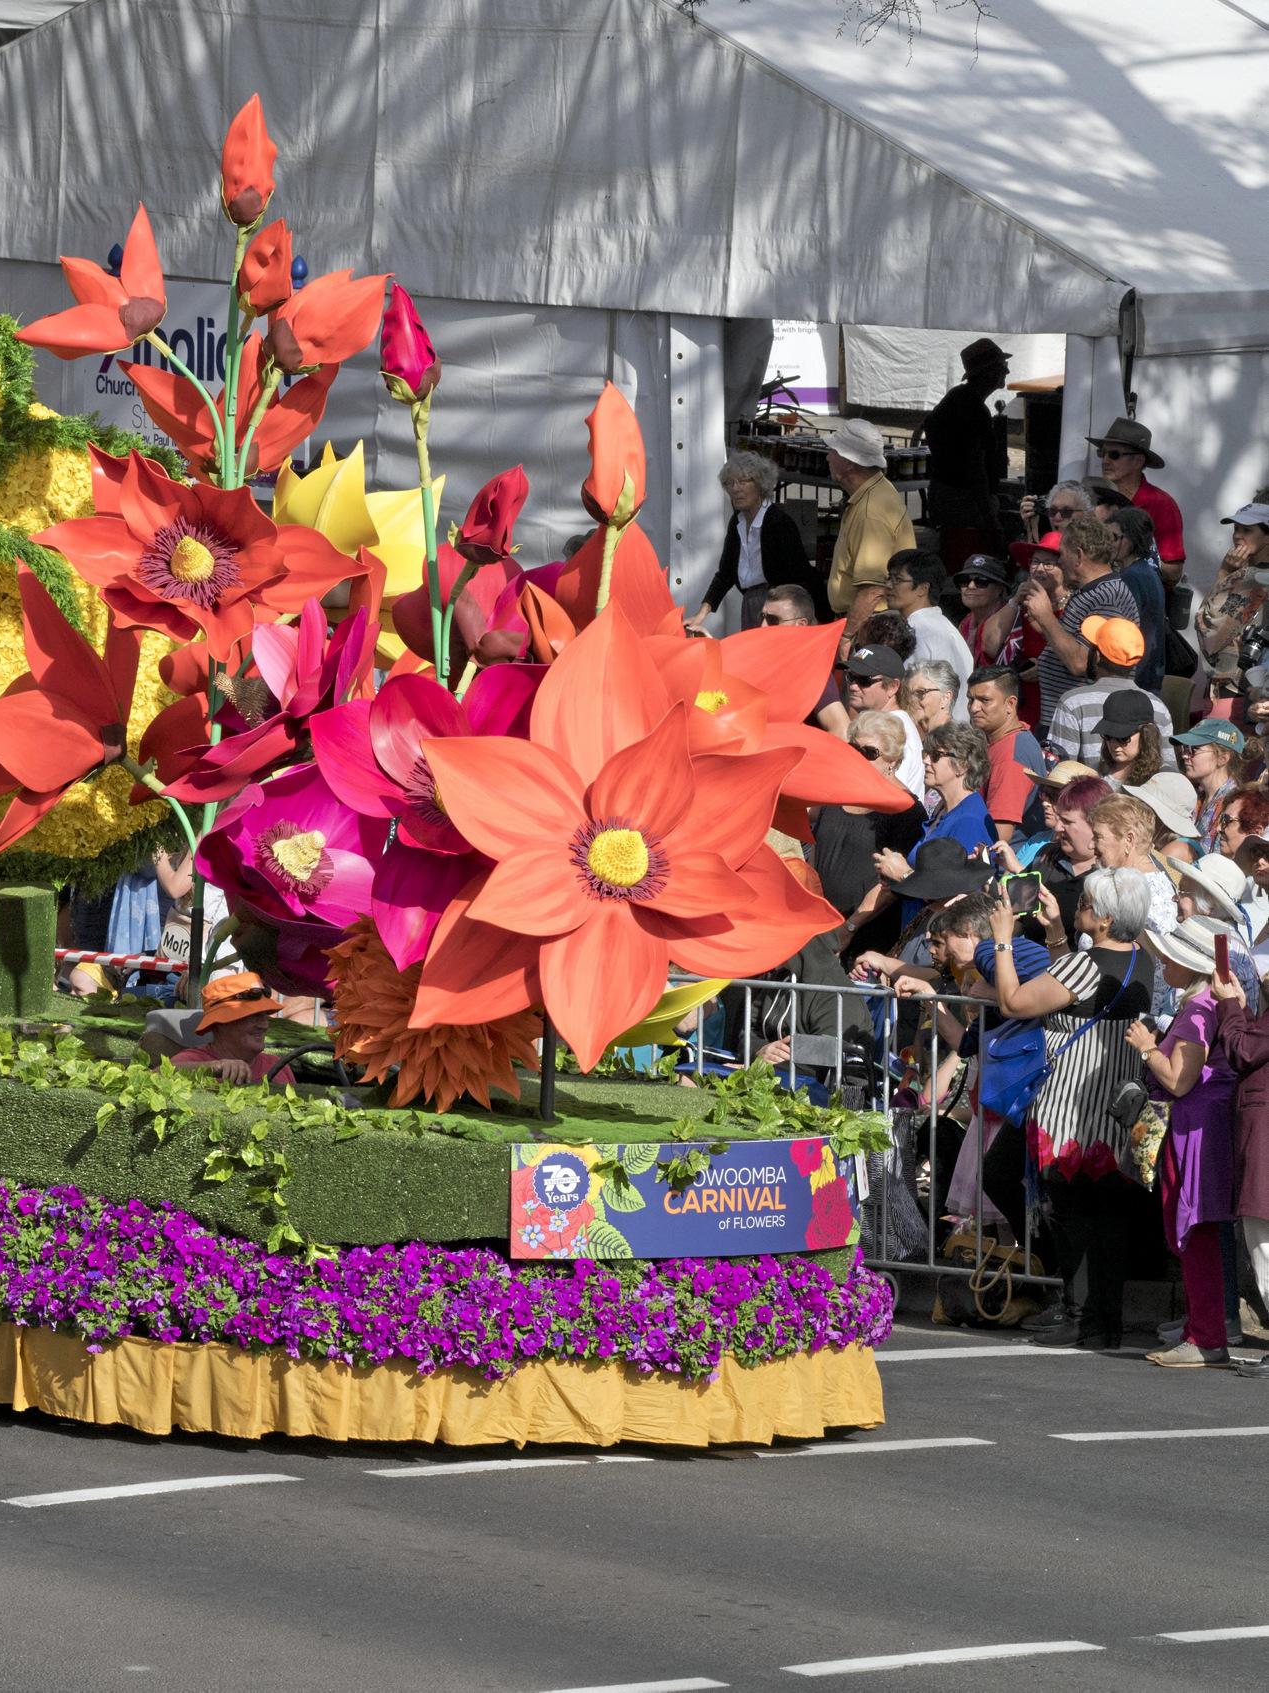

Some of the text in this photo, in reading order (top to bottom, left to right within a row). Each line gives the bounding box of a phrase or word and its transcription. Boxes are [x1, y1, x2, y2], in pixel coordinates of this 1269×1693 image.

[542, 1164, 578, 1194] 70
[545, 1191, 580, 1204] Years
[663, 1186, 787, 1215] CARNIVAL
[718, 1215, 786, 1230] of FLOWERS
